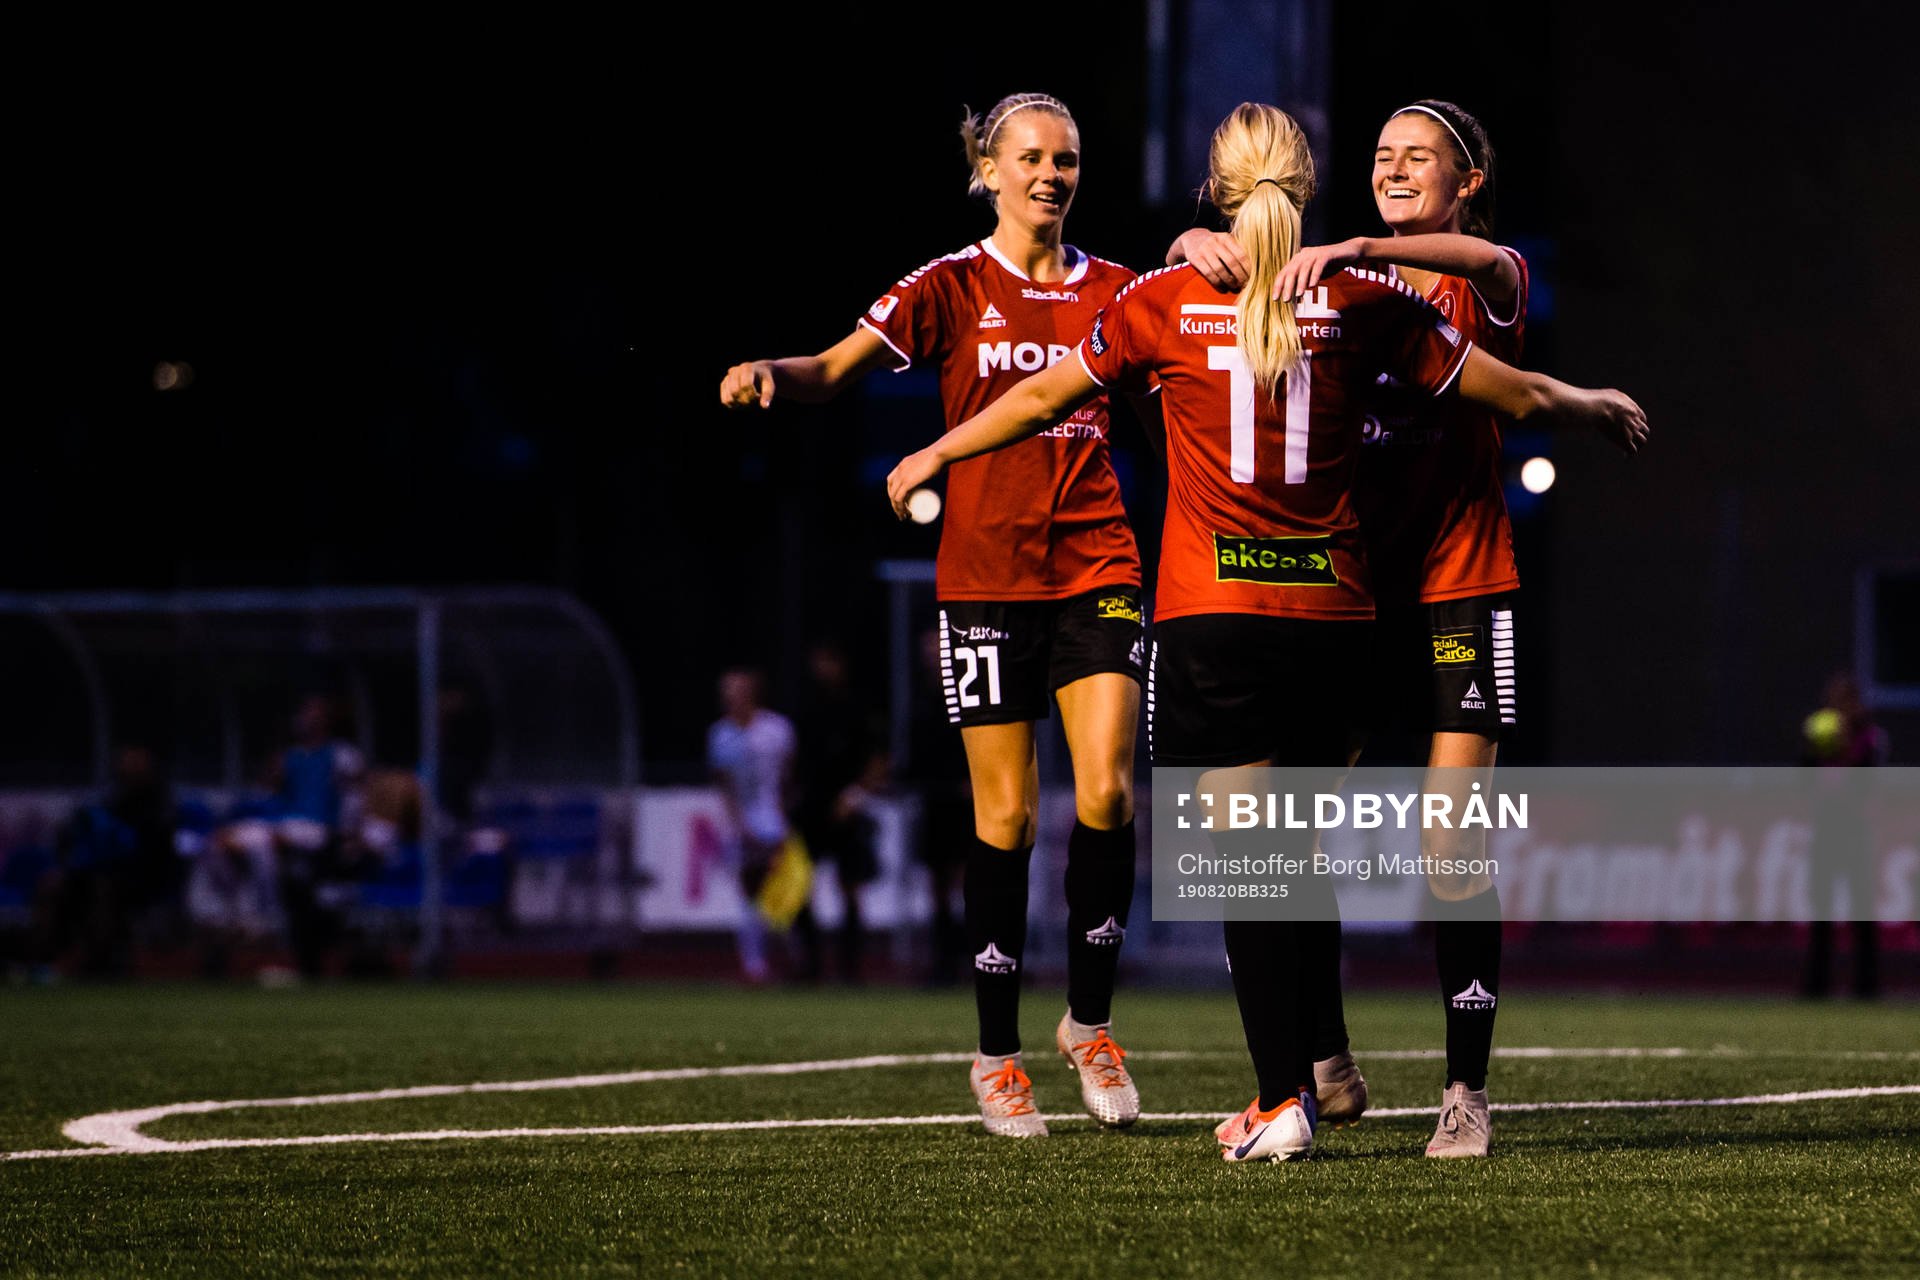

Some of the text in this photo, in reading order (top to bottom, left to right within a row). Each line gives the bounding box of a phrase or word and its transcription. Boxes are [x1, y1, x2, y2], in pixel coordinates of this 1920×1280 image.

[1021, 287, 1079, 303] stadium
[978, 319, 1007, 329] SELECT
[1207, 345, 1313, 485] 11
[1434, 645, 1476, 660] CarGo
[954, 645, 1001, 708] 21
[1461, 700, 1486, 709] SELECT
